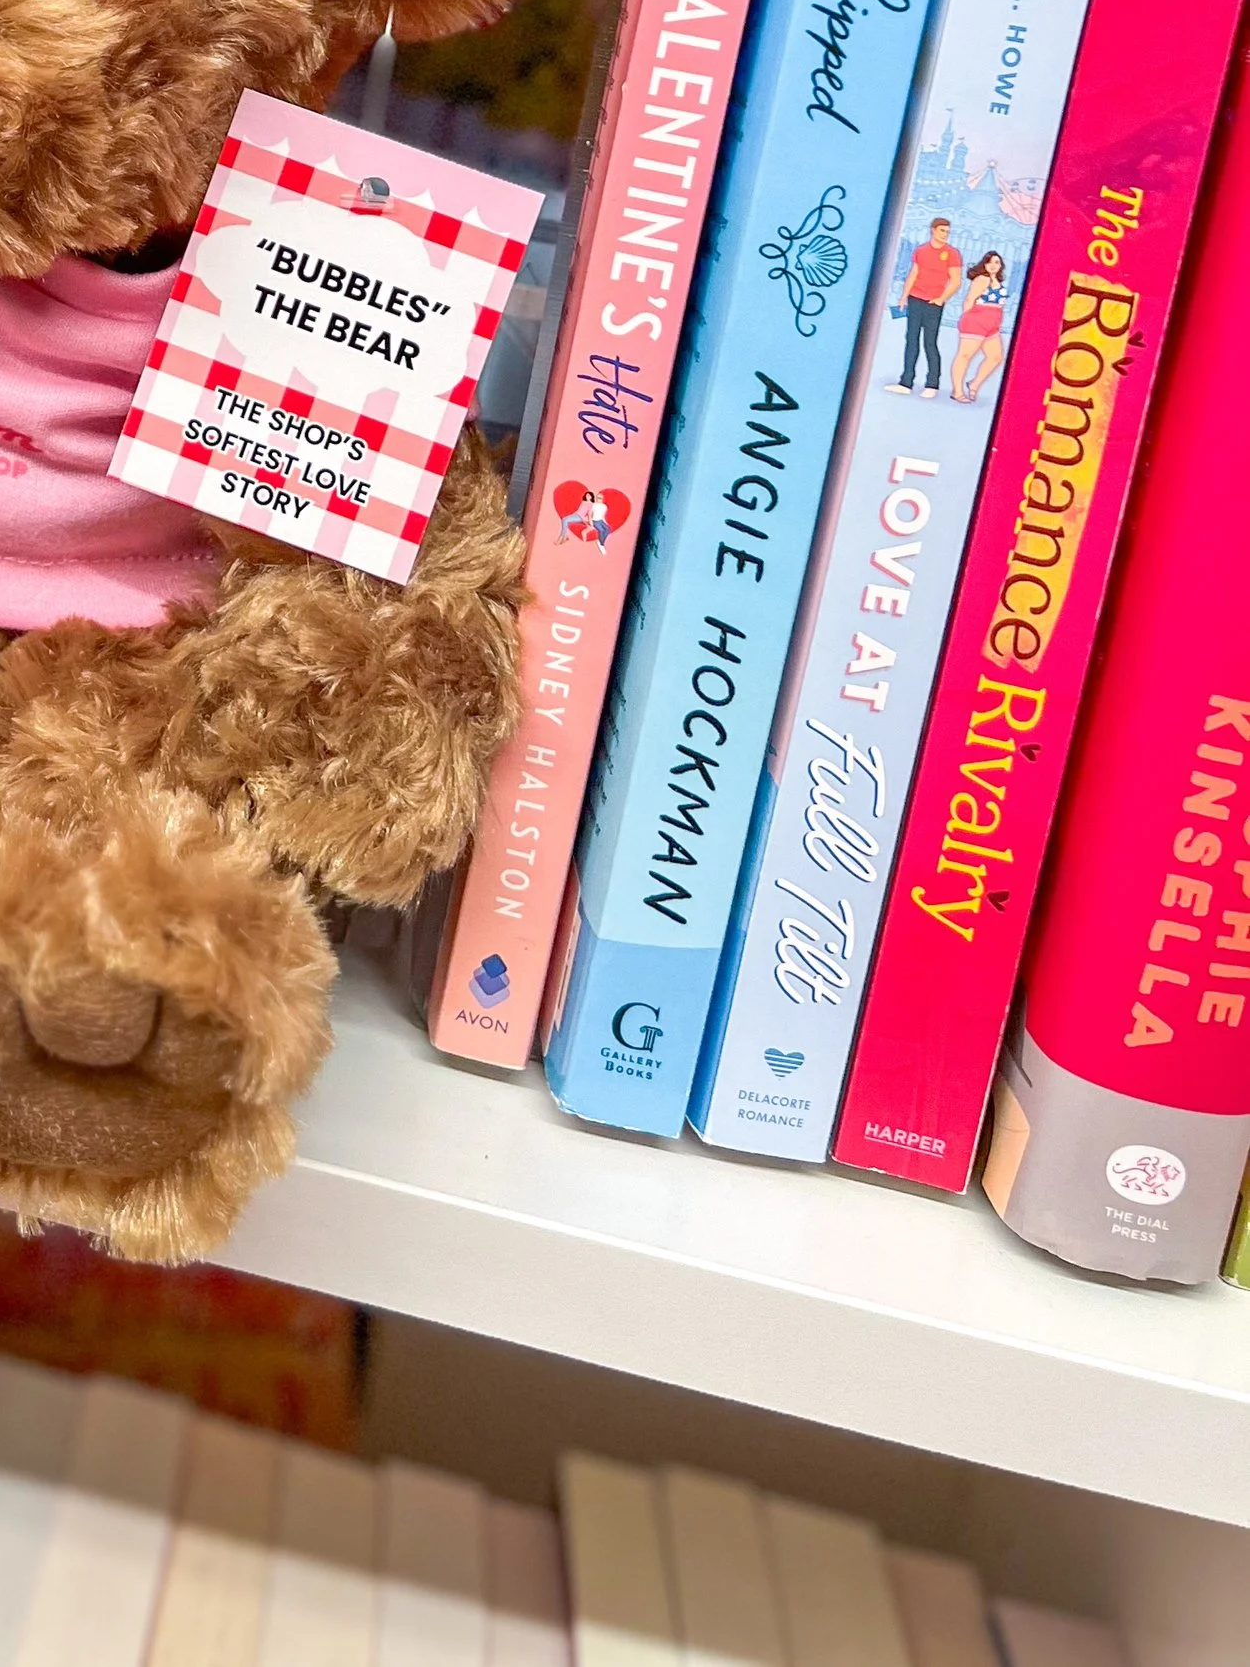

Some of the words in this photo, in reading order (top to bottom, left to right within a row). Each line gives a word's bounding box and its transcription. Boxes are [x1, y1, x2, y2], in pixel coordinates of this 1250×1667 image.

[989, 23, 1027, 117] HOWE
[1087, 186, 1145, 267] The
[256, 237, 451, 324] “BUBBLES”
[252, 284, 318, 333] THE
[323, 313, 421, 371] BEAR
[215, 388, 265, 424] THE
[268, 410, 366, 461] SHOP’S
[578, 353, 655, 455] Hate
[184, 419, 299, 475] SOFTEST
[301, 462, 371, 504] LOVE
[220, 472, 310, 519] STORY
[715, 370, 800, 583] ANGIE
[991, 279, 1132, 672] Romance
[858, 455, 941, 619] LOVE
[535, 581, 590, 726] SIDNEY
[842, 638, 901, 713] AT
[643, 615, 747, 925] HOCKMAN
[803, 717, 886, 883] Full
[912, 672, 1047, 943] Rivalry
[495, 744, 556, 920] HALSTON
[1123, 694, 1250, 1047] KINSELLA
[774, 878, 855, 1006] Tilt
[455, 1009, 509, 1035] AVON
[600, 1046, 663, 1069] GALLERY
[604, 1060, 653, 1080] BOOKS
[738, 1089, 811, 1111] DELACORTE
[737, 1110, 804, 1129] ROMANCE
[864, 1122, 946, 1156] HARPER
[1105, 1206, 1133, 1223] THE
[1137, 1215, 1170, 1231] DIAL
[1111, 1224, 1157, 1243] PRESS
